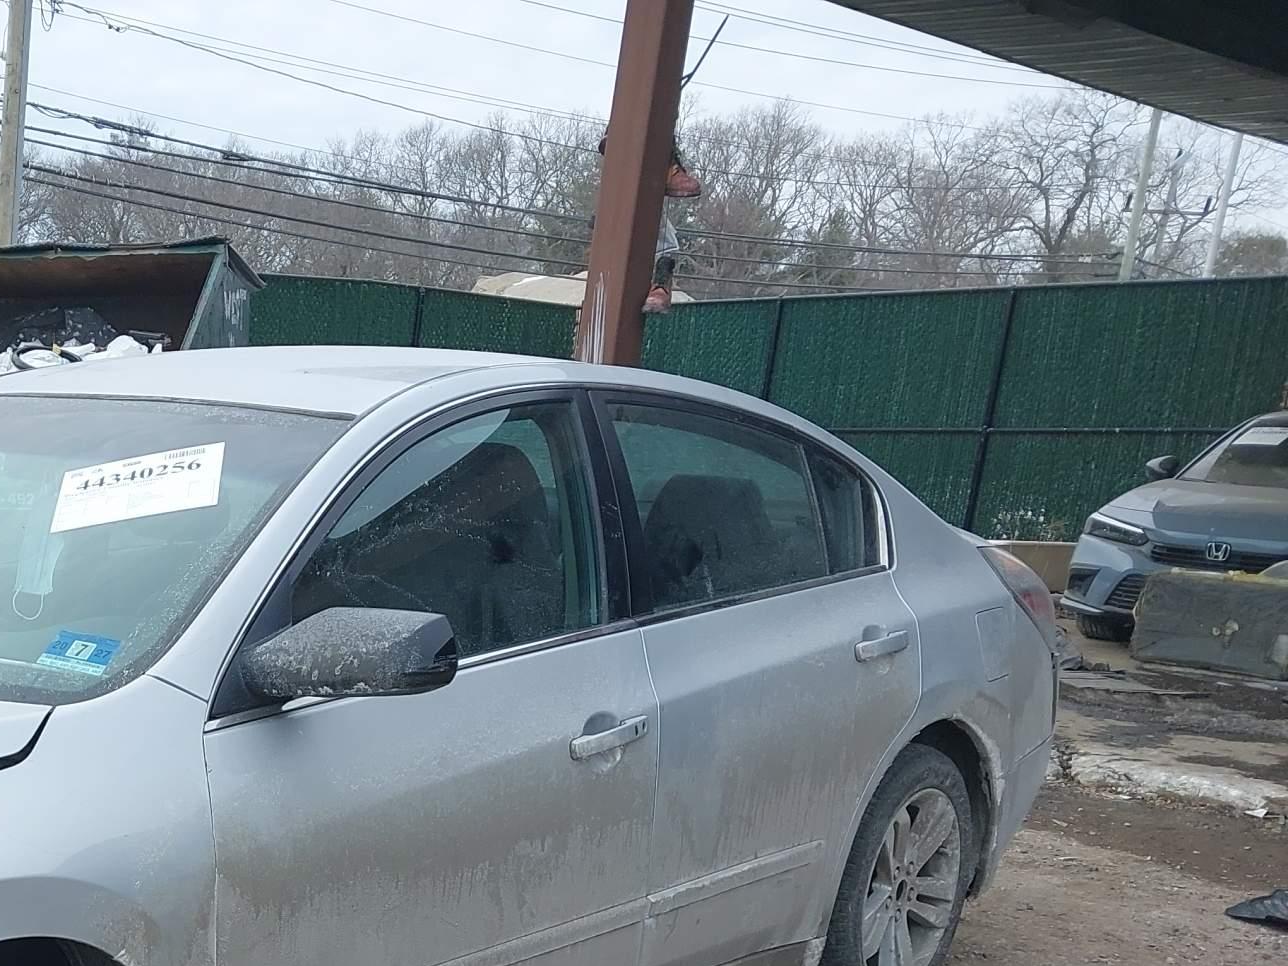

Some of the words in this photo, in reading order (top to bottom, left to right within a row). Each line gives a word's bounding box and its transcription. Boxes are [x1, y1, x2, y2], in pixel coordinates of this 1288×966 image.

[76, 457, 202, 491] 44340256
[53, 640, 69, 650] 20
[75, 643, 89, 657] 7
[94, 648, 113, 659] 27
